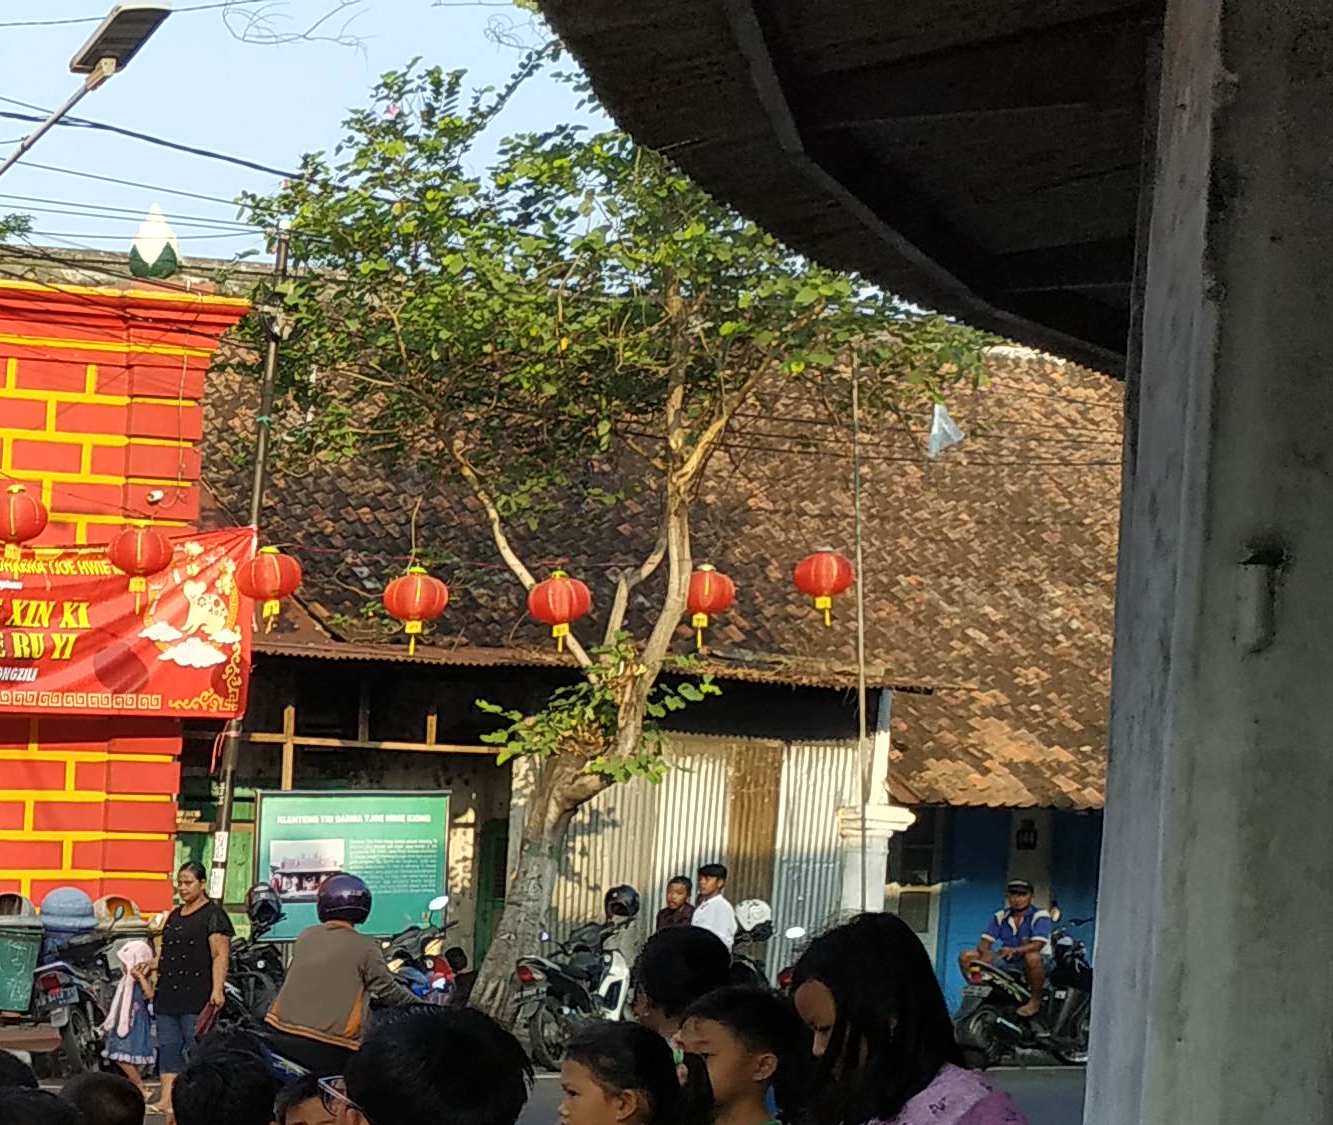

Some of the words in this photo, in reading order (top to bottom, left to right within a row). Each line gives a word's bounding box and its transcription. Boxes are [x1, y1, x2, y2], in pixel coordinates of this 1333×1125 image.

[5, 599, 56, 628] XIN
[11, 632, 45, 659] RU
[50, 633, 78, 660] YI
